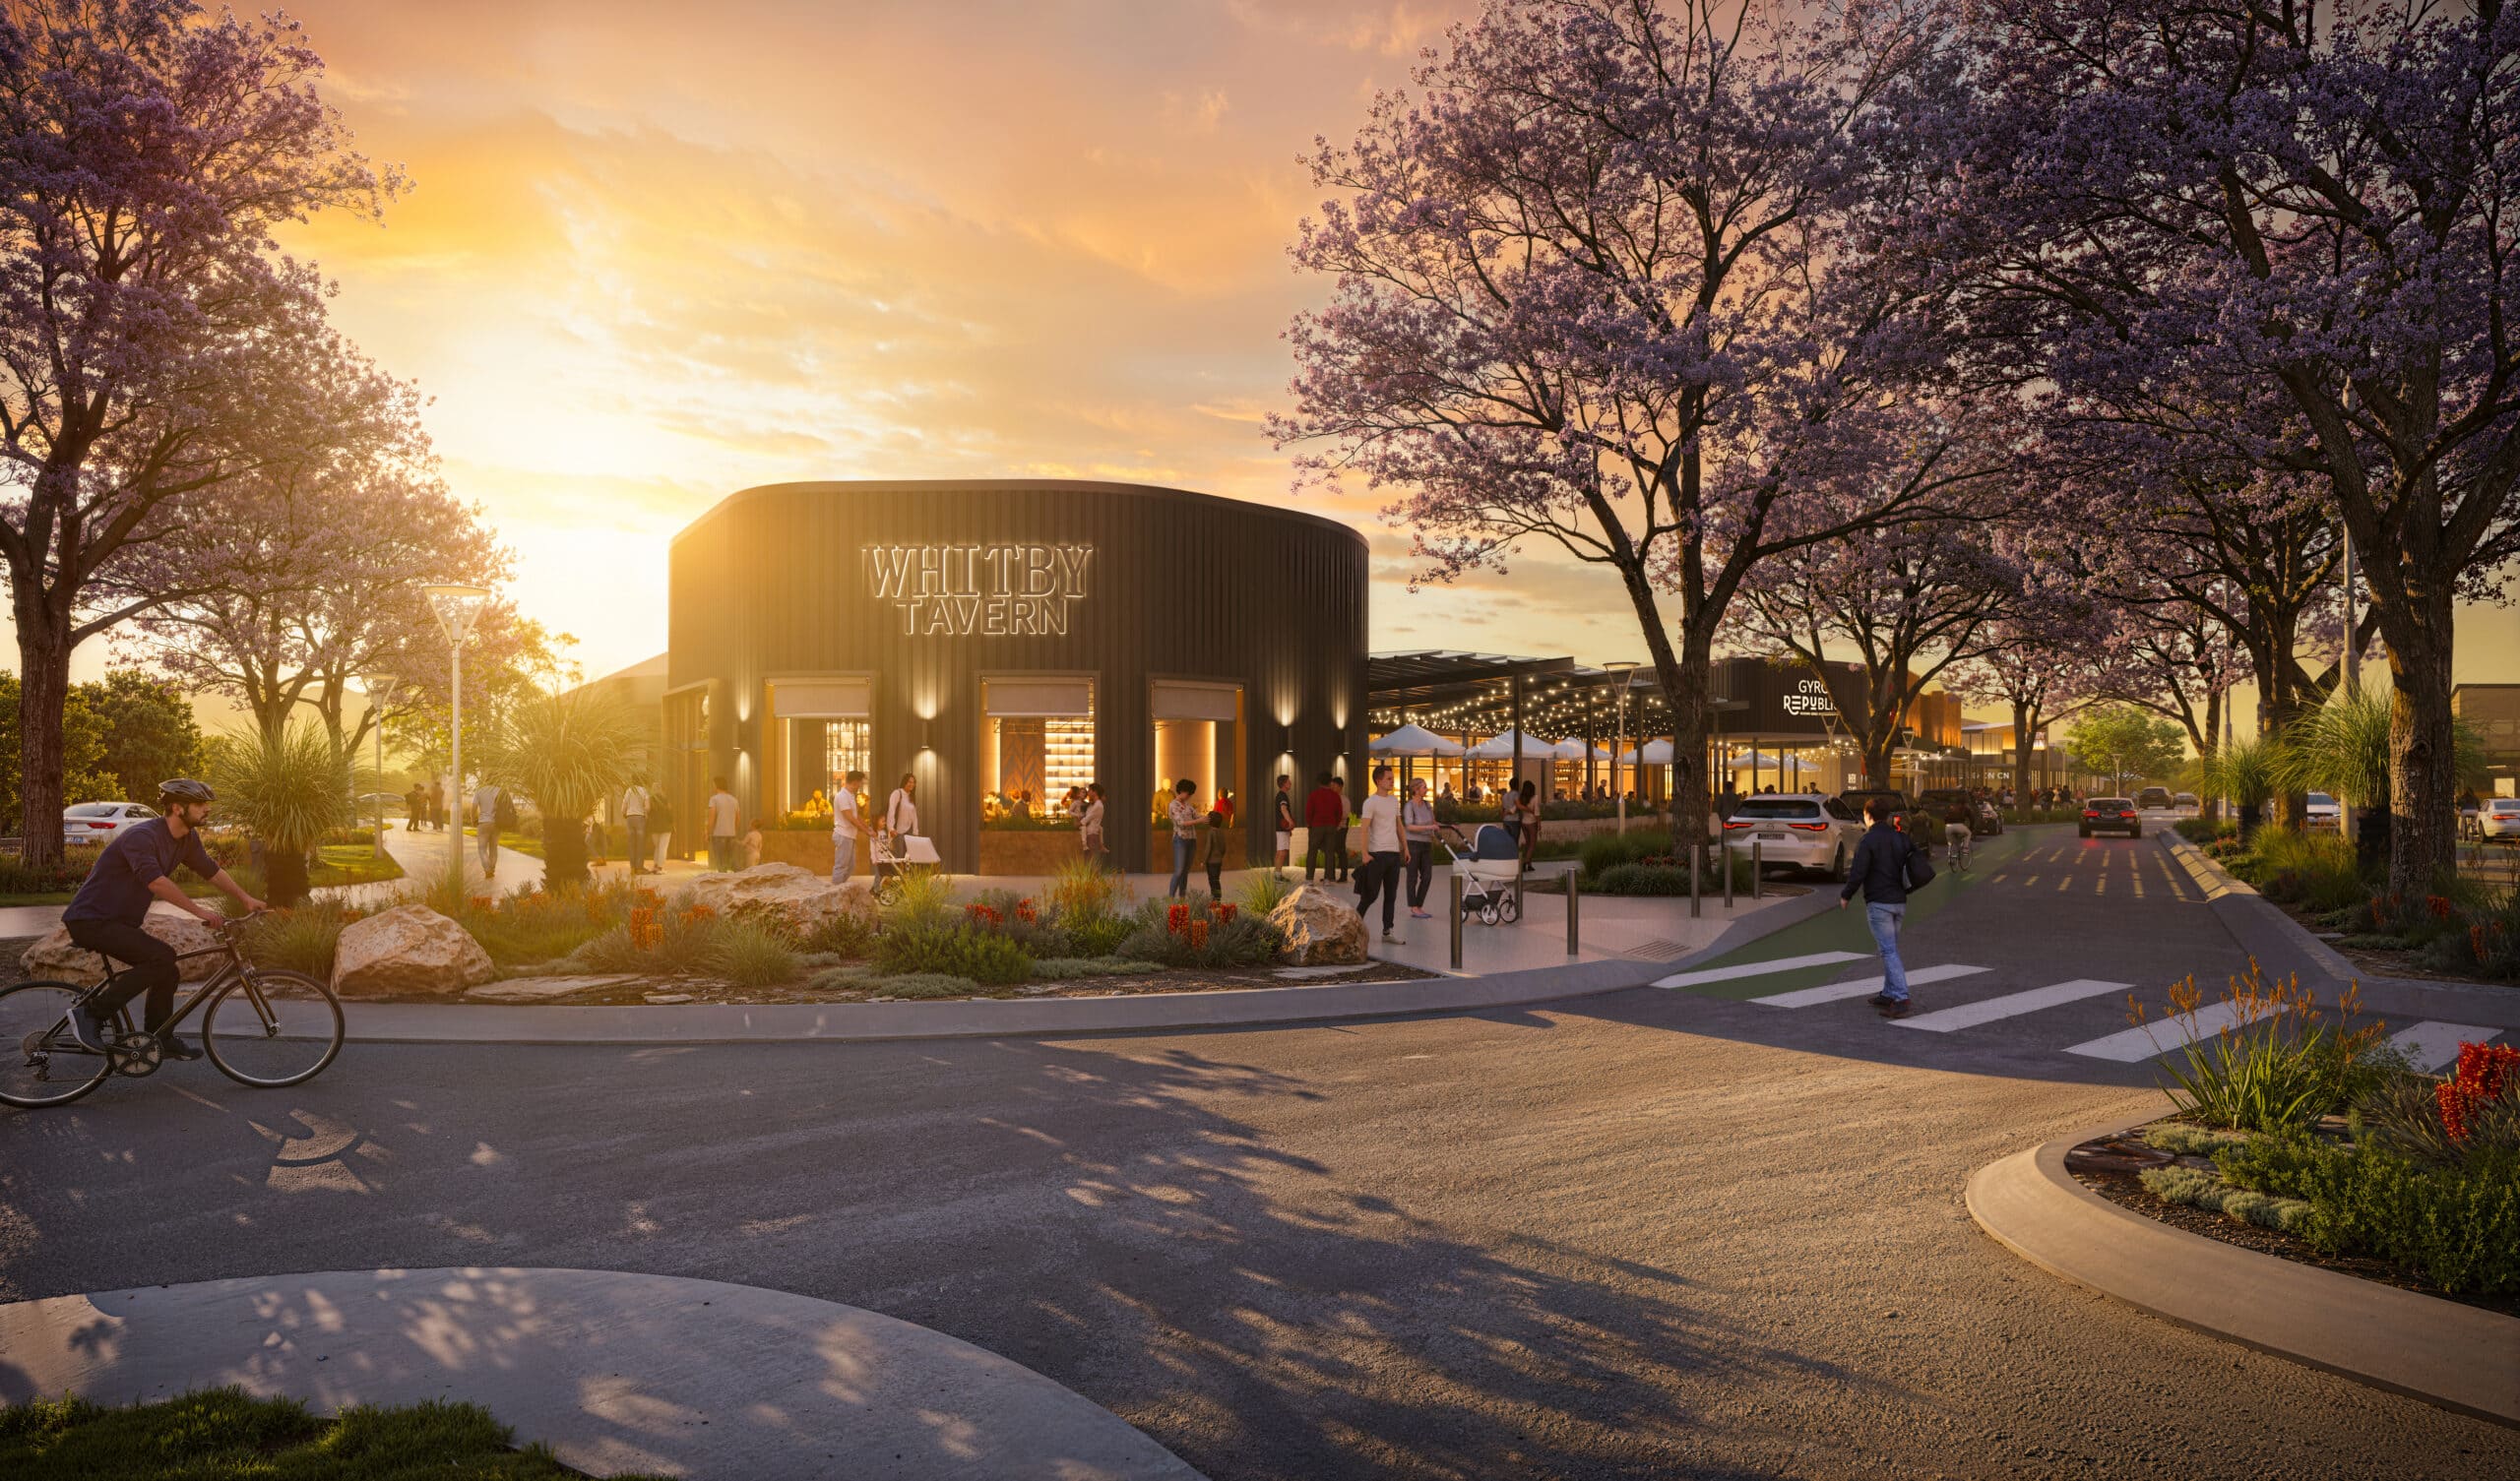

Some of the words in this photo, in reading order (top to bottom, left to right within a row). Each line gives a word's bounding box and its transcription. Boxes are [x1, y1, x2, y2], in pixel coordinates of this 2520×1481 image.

[859, 543, 1094, 598] WHITBY
[892, 597, 1067, 635] TAVERN
[1783, 695, 1838, 715] REPUBLI
